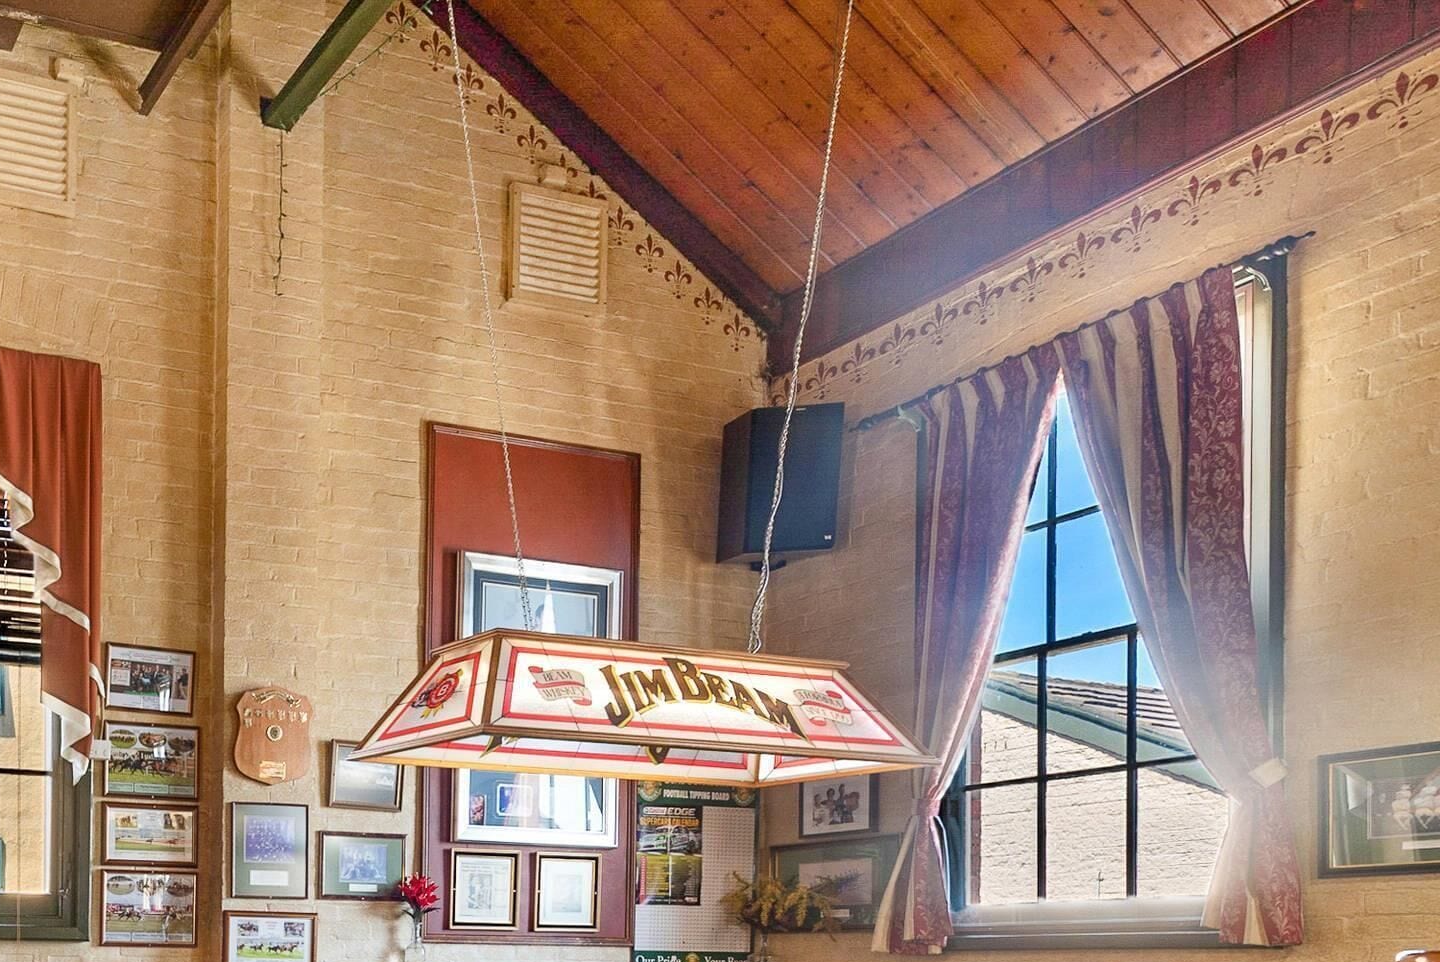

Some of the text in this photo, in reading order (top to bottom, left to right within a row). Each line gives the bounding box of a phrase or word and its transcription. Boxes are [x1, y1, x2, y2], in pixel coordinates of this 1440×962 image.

[542, 671, 573, 682] BEAM
[599, 657, 816, 748] JIM BEAM
[663, 789, 730, 801] FOOTBALL TIPPING BOARD
[668, 808, 696, 816] EDGE
